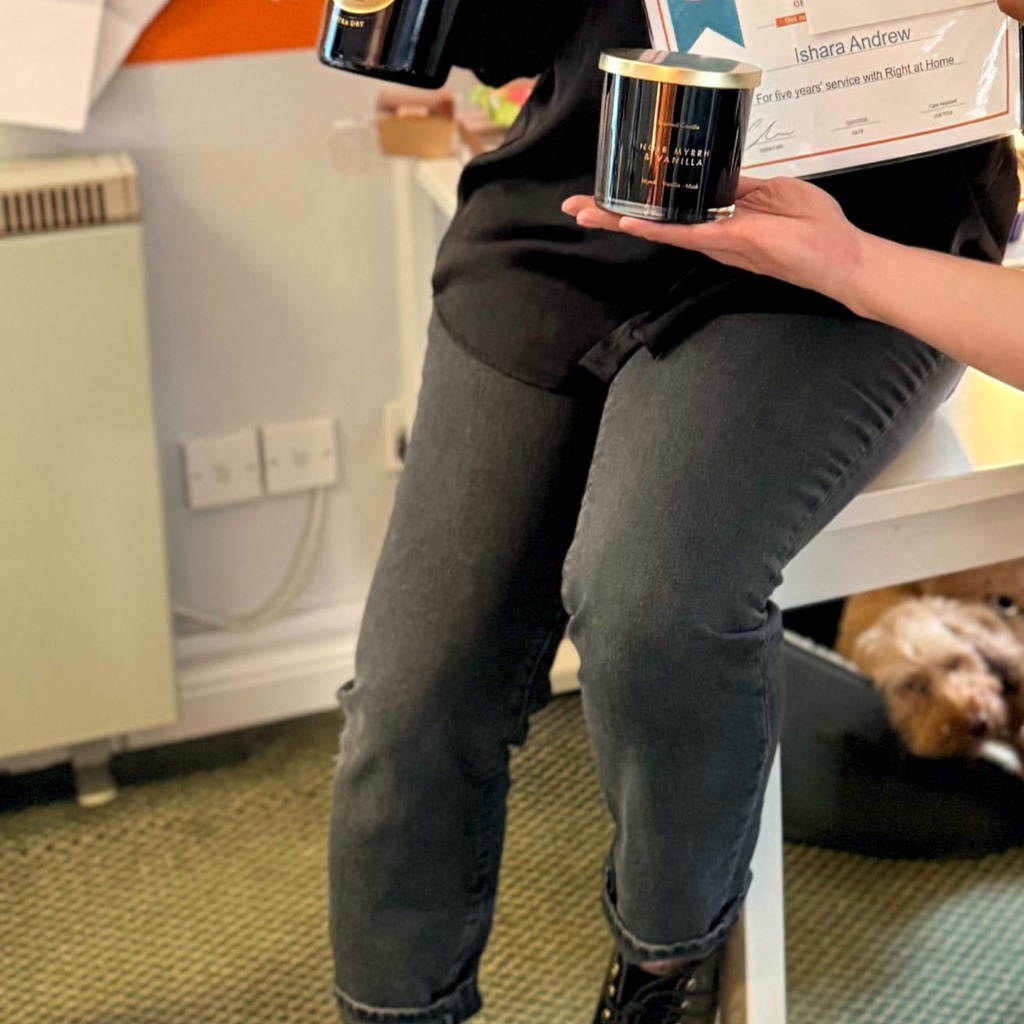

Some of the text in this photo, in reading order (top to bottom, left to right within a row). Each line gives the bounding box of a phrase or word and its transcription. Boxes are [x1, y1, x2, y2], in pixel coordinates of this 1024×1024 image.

[794, 28, 911, 63] Ishara Andrew
[756, 55, 955, 104] For five years' service with Right at Home
[640, 142, 710, 157] NOR MYRRH
[657, 155, 703, 166] VANILLA
